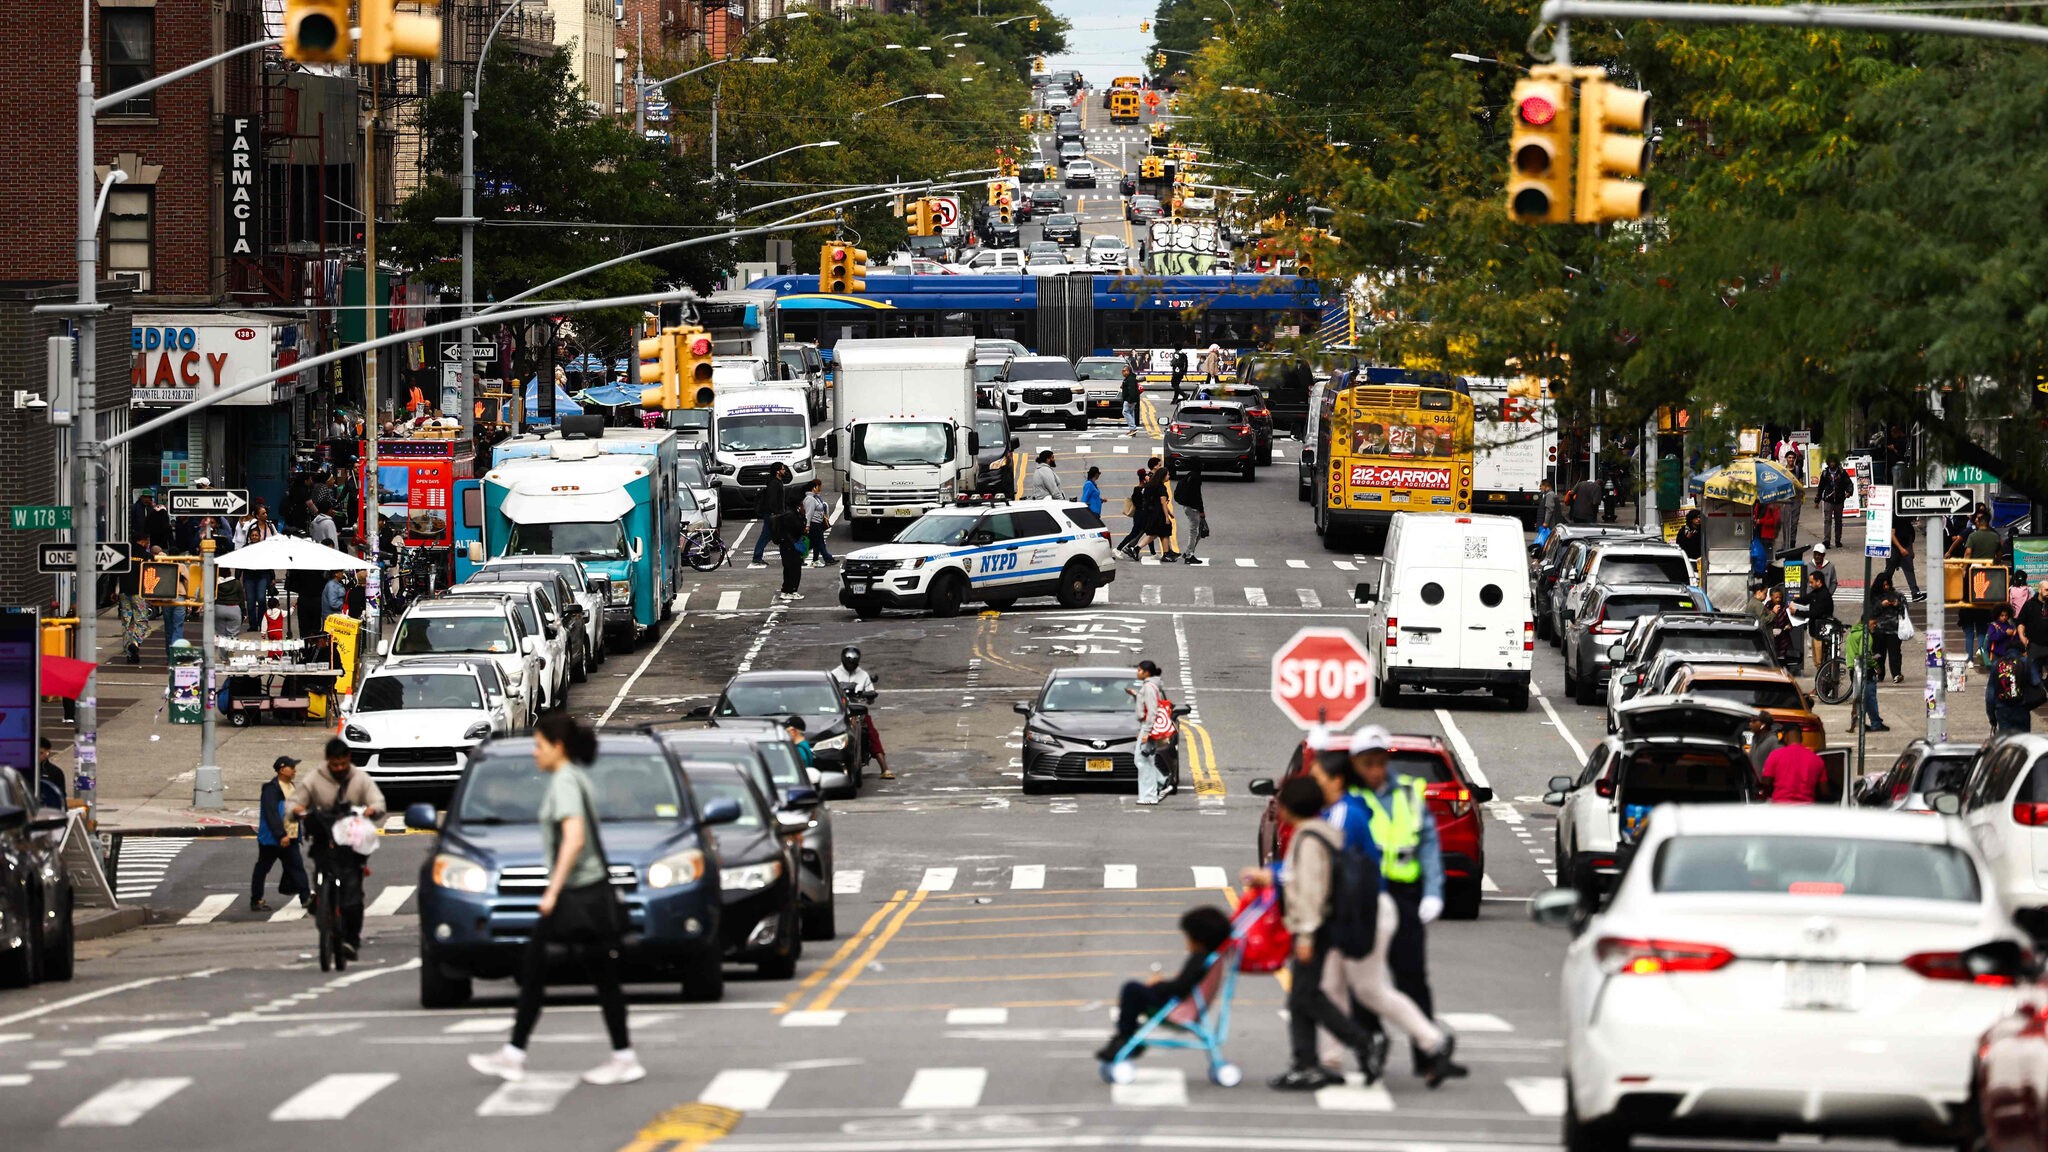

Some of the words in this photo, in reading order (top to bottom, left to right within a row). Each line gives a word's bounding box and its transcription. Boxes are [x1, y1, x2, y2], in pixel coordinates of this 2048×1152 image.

[232, 119, 252, 253] FARMACIA
[236, 330, 254, 338] 1381
[728, 408, 763, 416] PLUMBING
[1434, 415, 1456, 424] 9444
[1351, 468, 1450, 484] 212-CARRION
[1948, 467, 1958, 482] W
[1963, 466, 1983, 481] 178
[176, 497, 199, 508] ONE
[212, 497, 237, 508] WAY
[1904, 498, 1925, 508] ONE
[1939, 497, 1961, 507] WAY
[15, 510, 27, 526] W
[34, 510, 56, 526] 178
[62, 510, 72, 520] St
[48, 552, 73, 564] ONE
[96, 552, 115, 564] AY
[980, 552, 1018, 573] NYPD
[1280, 657, 1368, 700] STOP
